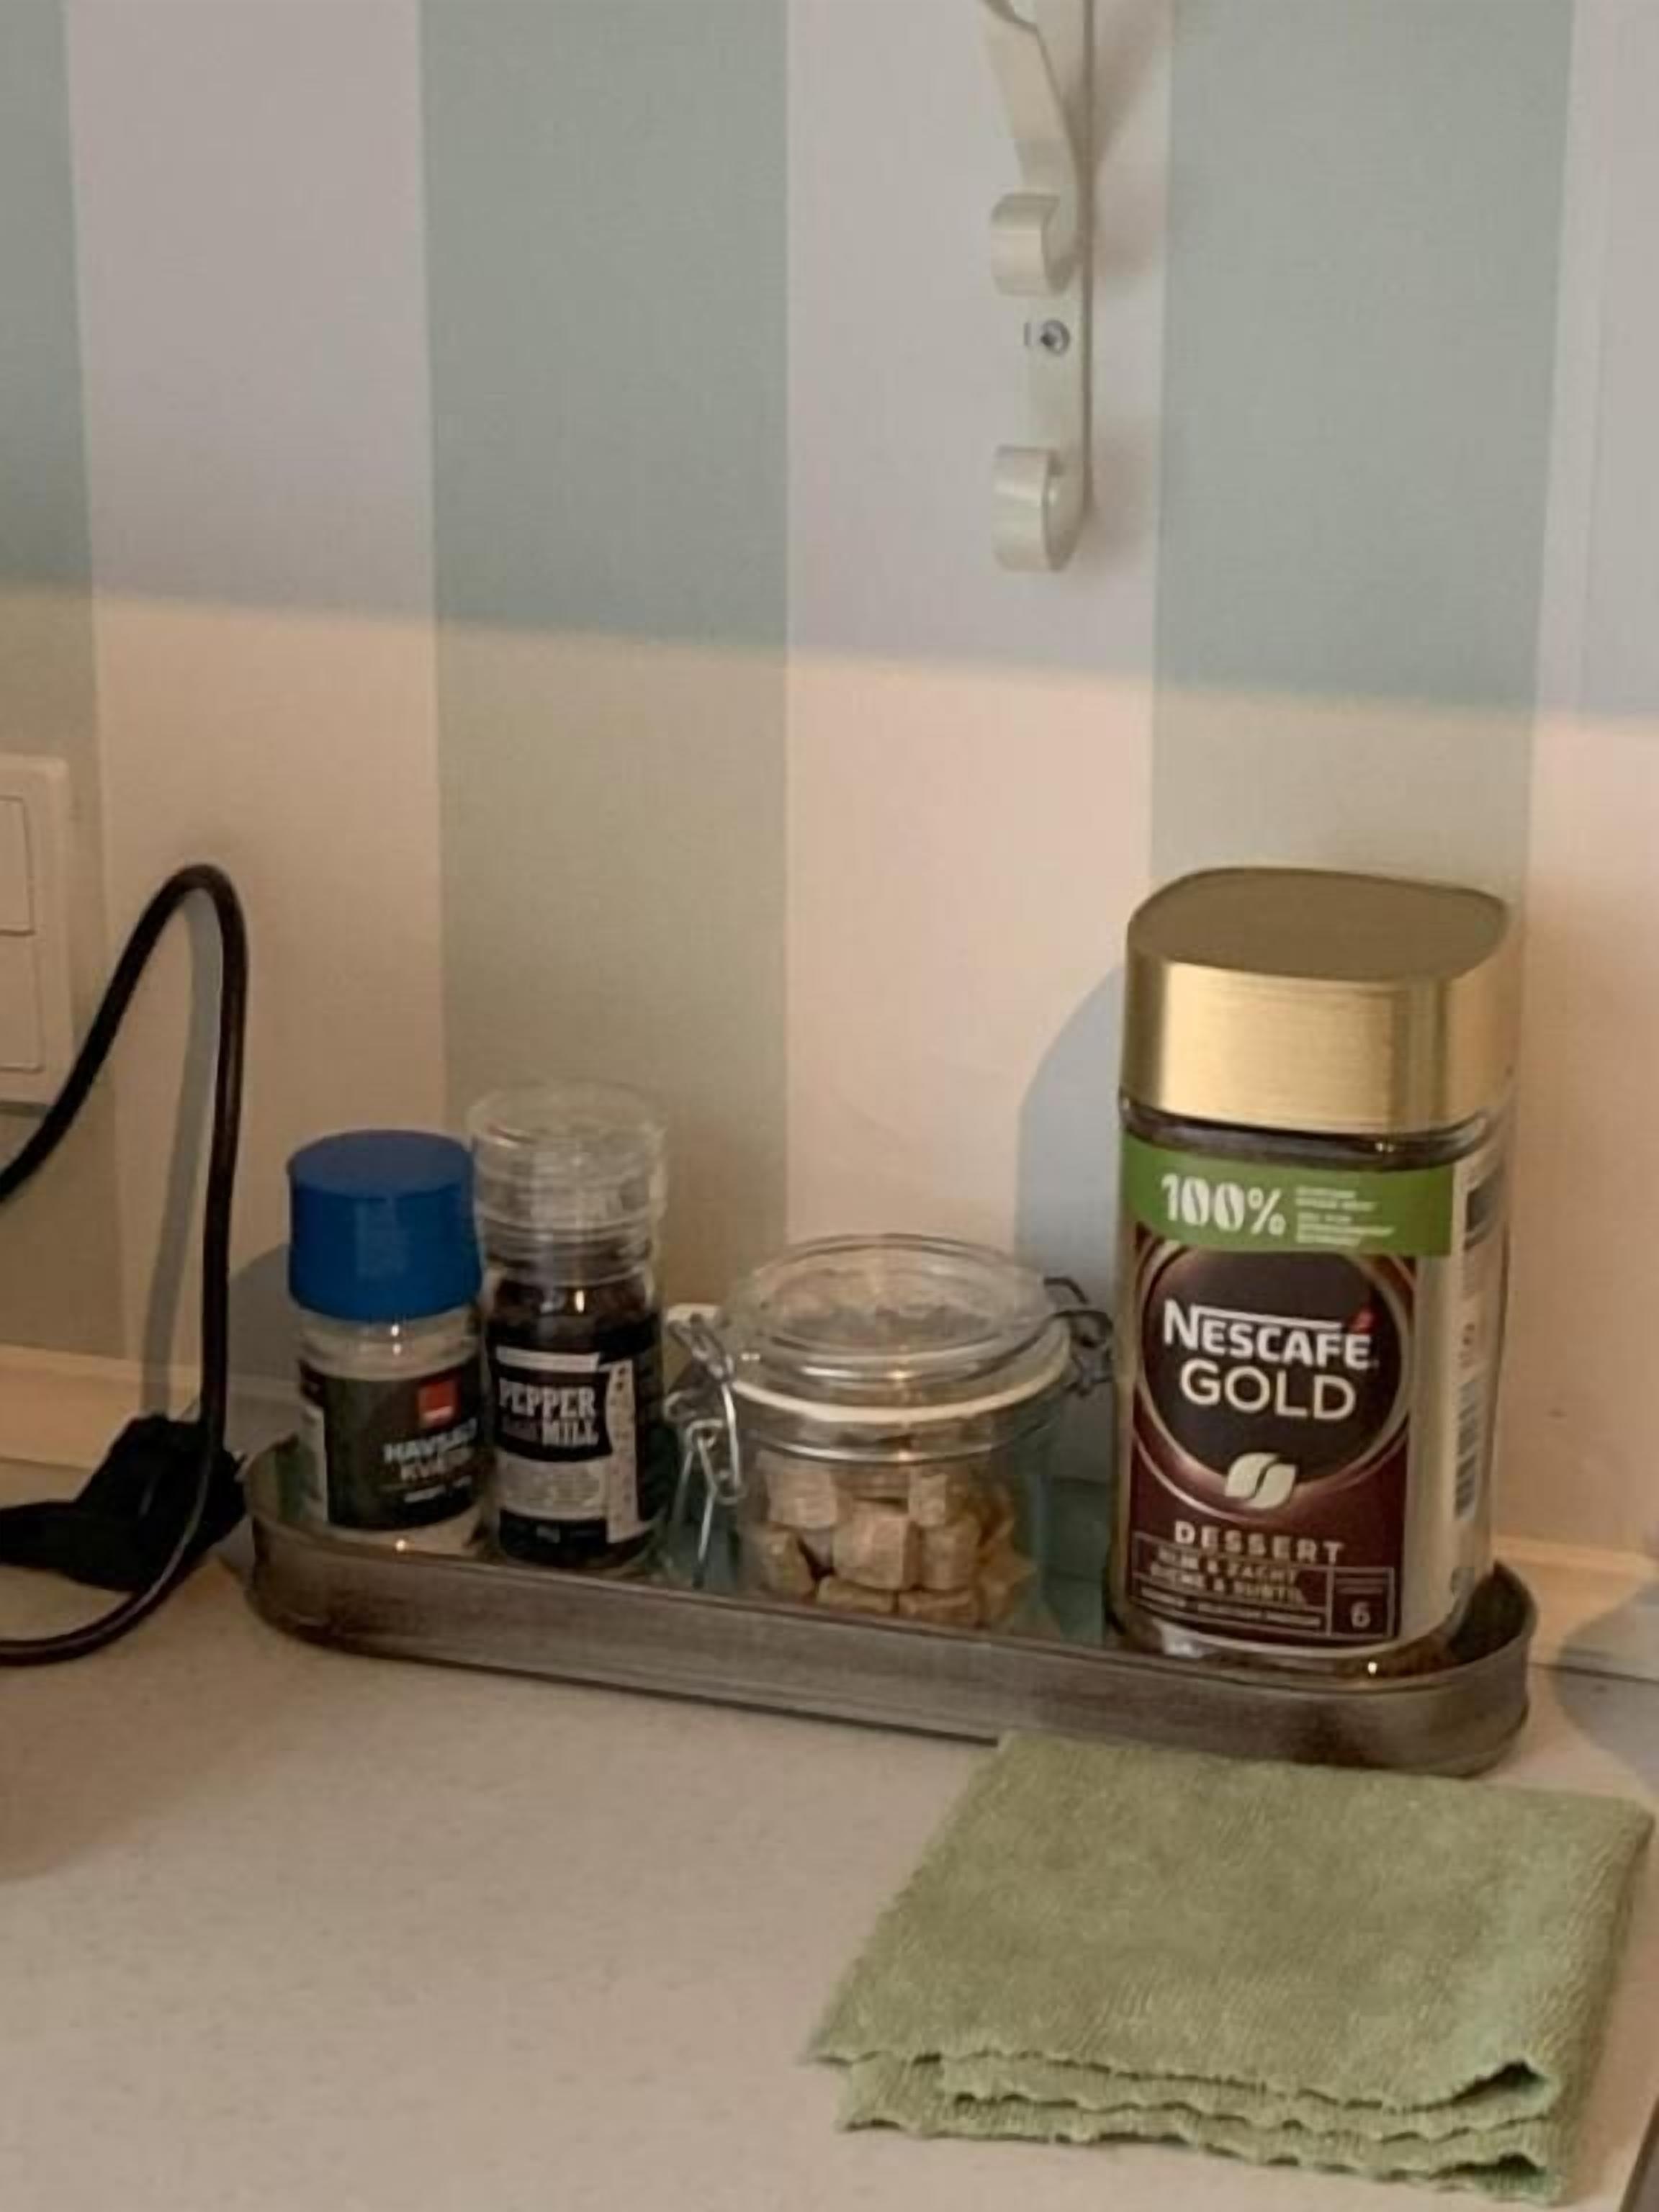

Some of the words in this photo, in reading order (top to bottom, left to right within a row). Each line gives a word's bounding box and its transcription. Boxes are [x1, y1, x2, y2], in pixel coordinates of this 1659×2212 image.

[1161, 1173, 1287, 1236] 100%
[498, 1377, 596, 1419] PEPPER
[1179, 1358, 1357, 1421] GOLD
[541, 1419, 600, 1447] MILL
[1174, 1520, 1345, 1564] DESSERT
[1351, 1601, 1371, 1629] 6
